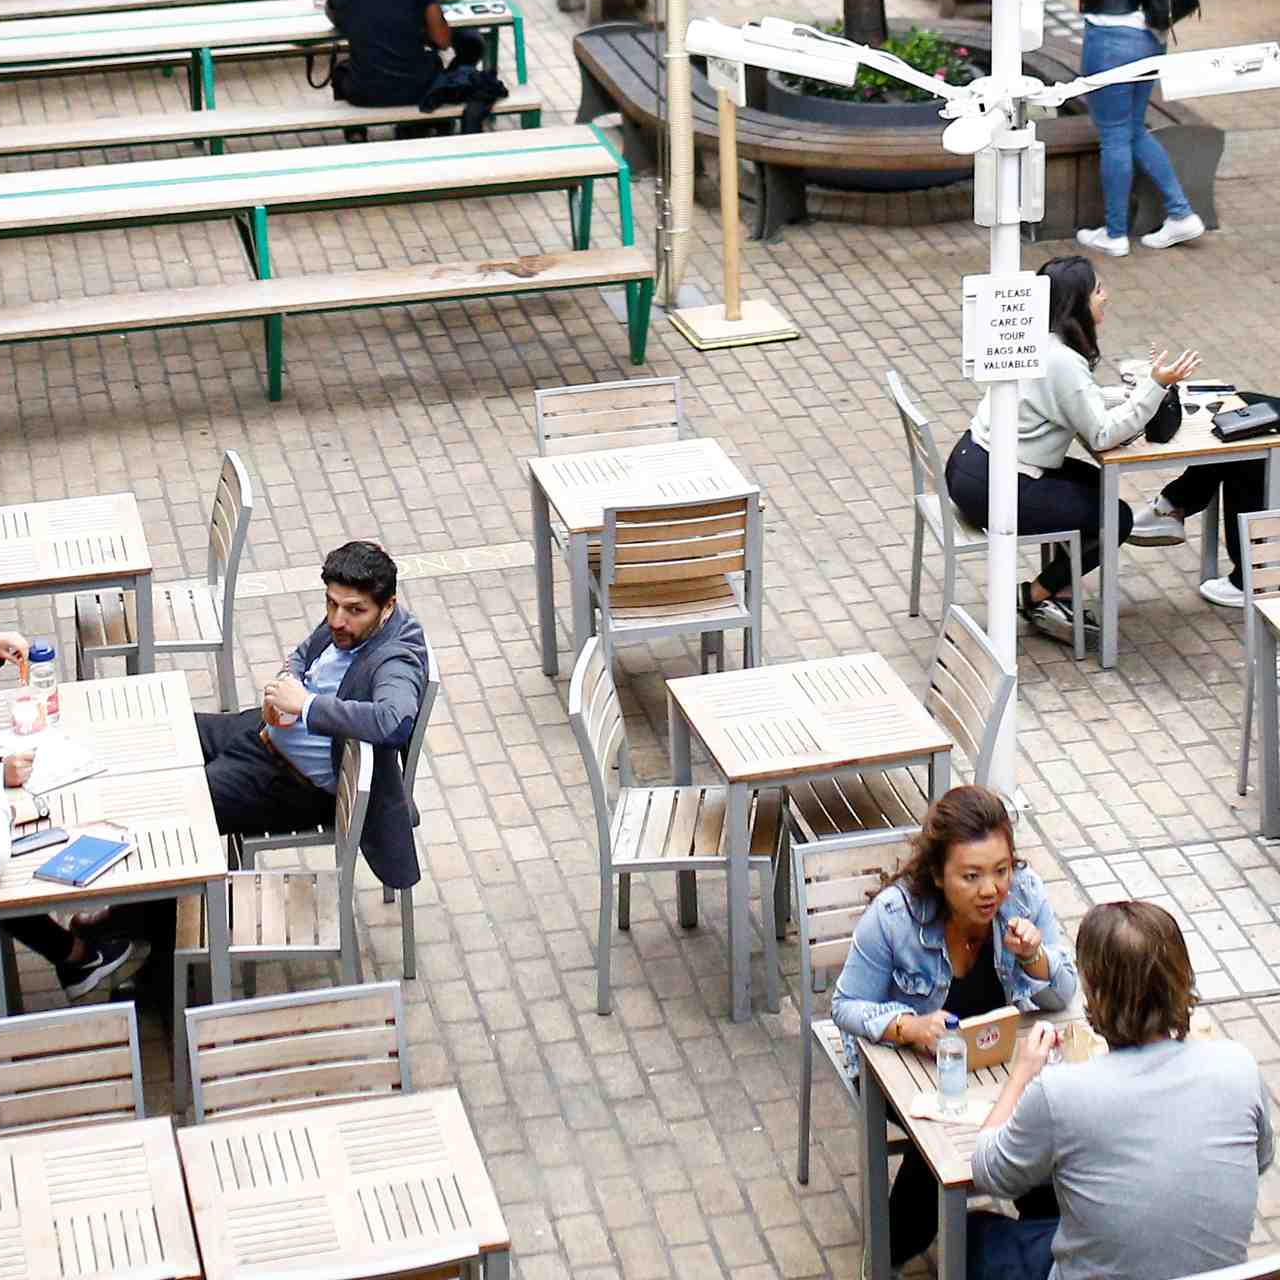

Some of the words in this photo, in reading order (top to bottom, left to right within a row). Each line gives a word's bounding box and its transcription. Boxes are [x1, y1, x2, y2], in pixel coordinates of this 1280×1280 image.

[994, 288, 1032, 299] PLEASE
[1001, 303, 1025, 312] TAKE
[990, 318, 1017, 327] CARE
[1020, 317, 1034, 326] OF
[1000, 331, 1025, 341] YOUR
[986, 346, 1014, 356] BAGS
[1016, 345, 1037, 354] AND
[983, 359, 1039, 370] VALUABLES
